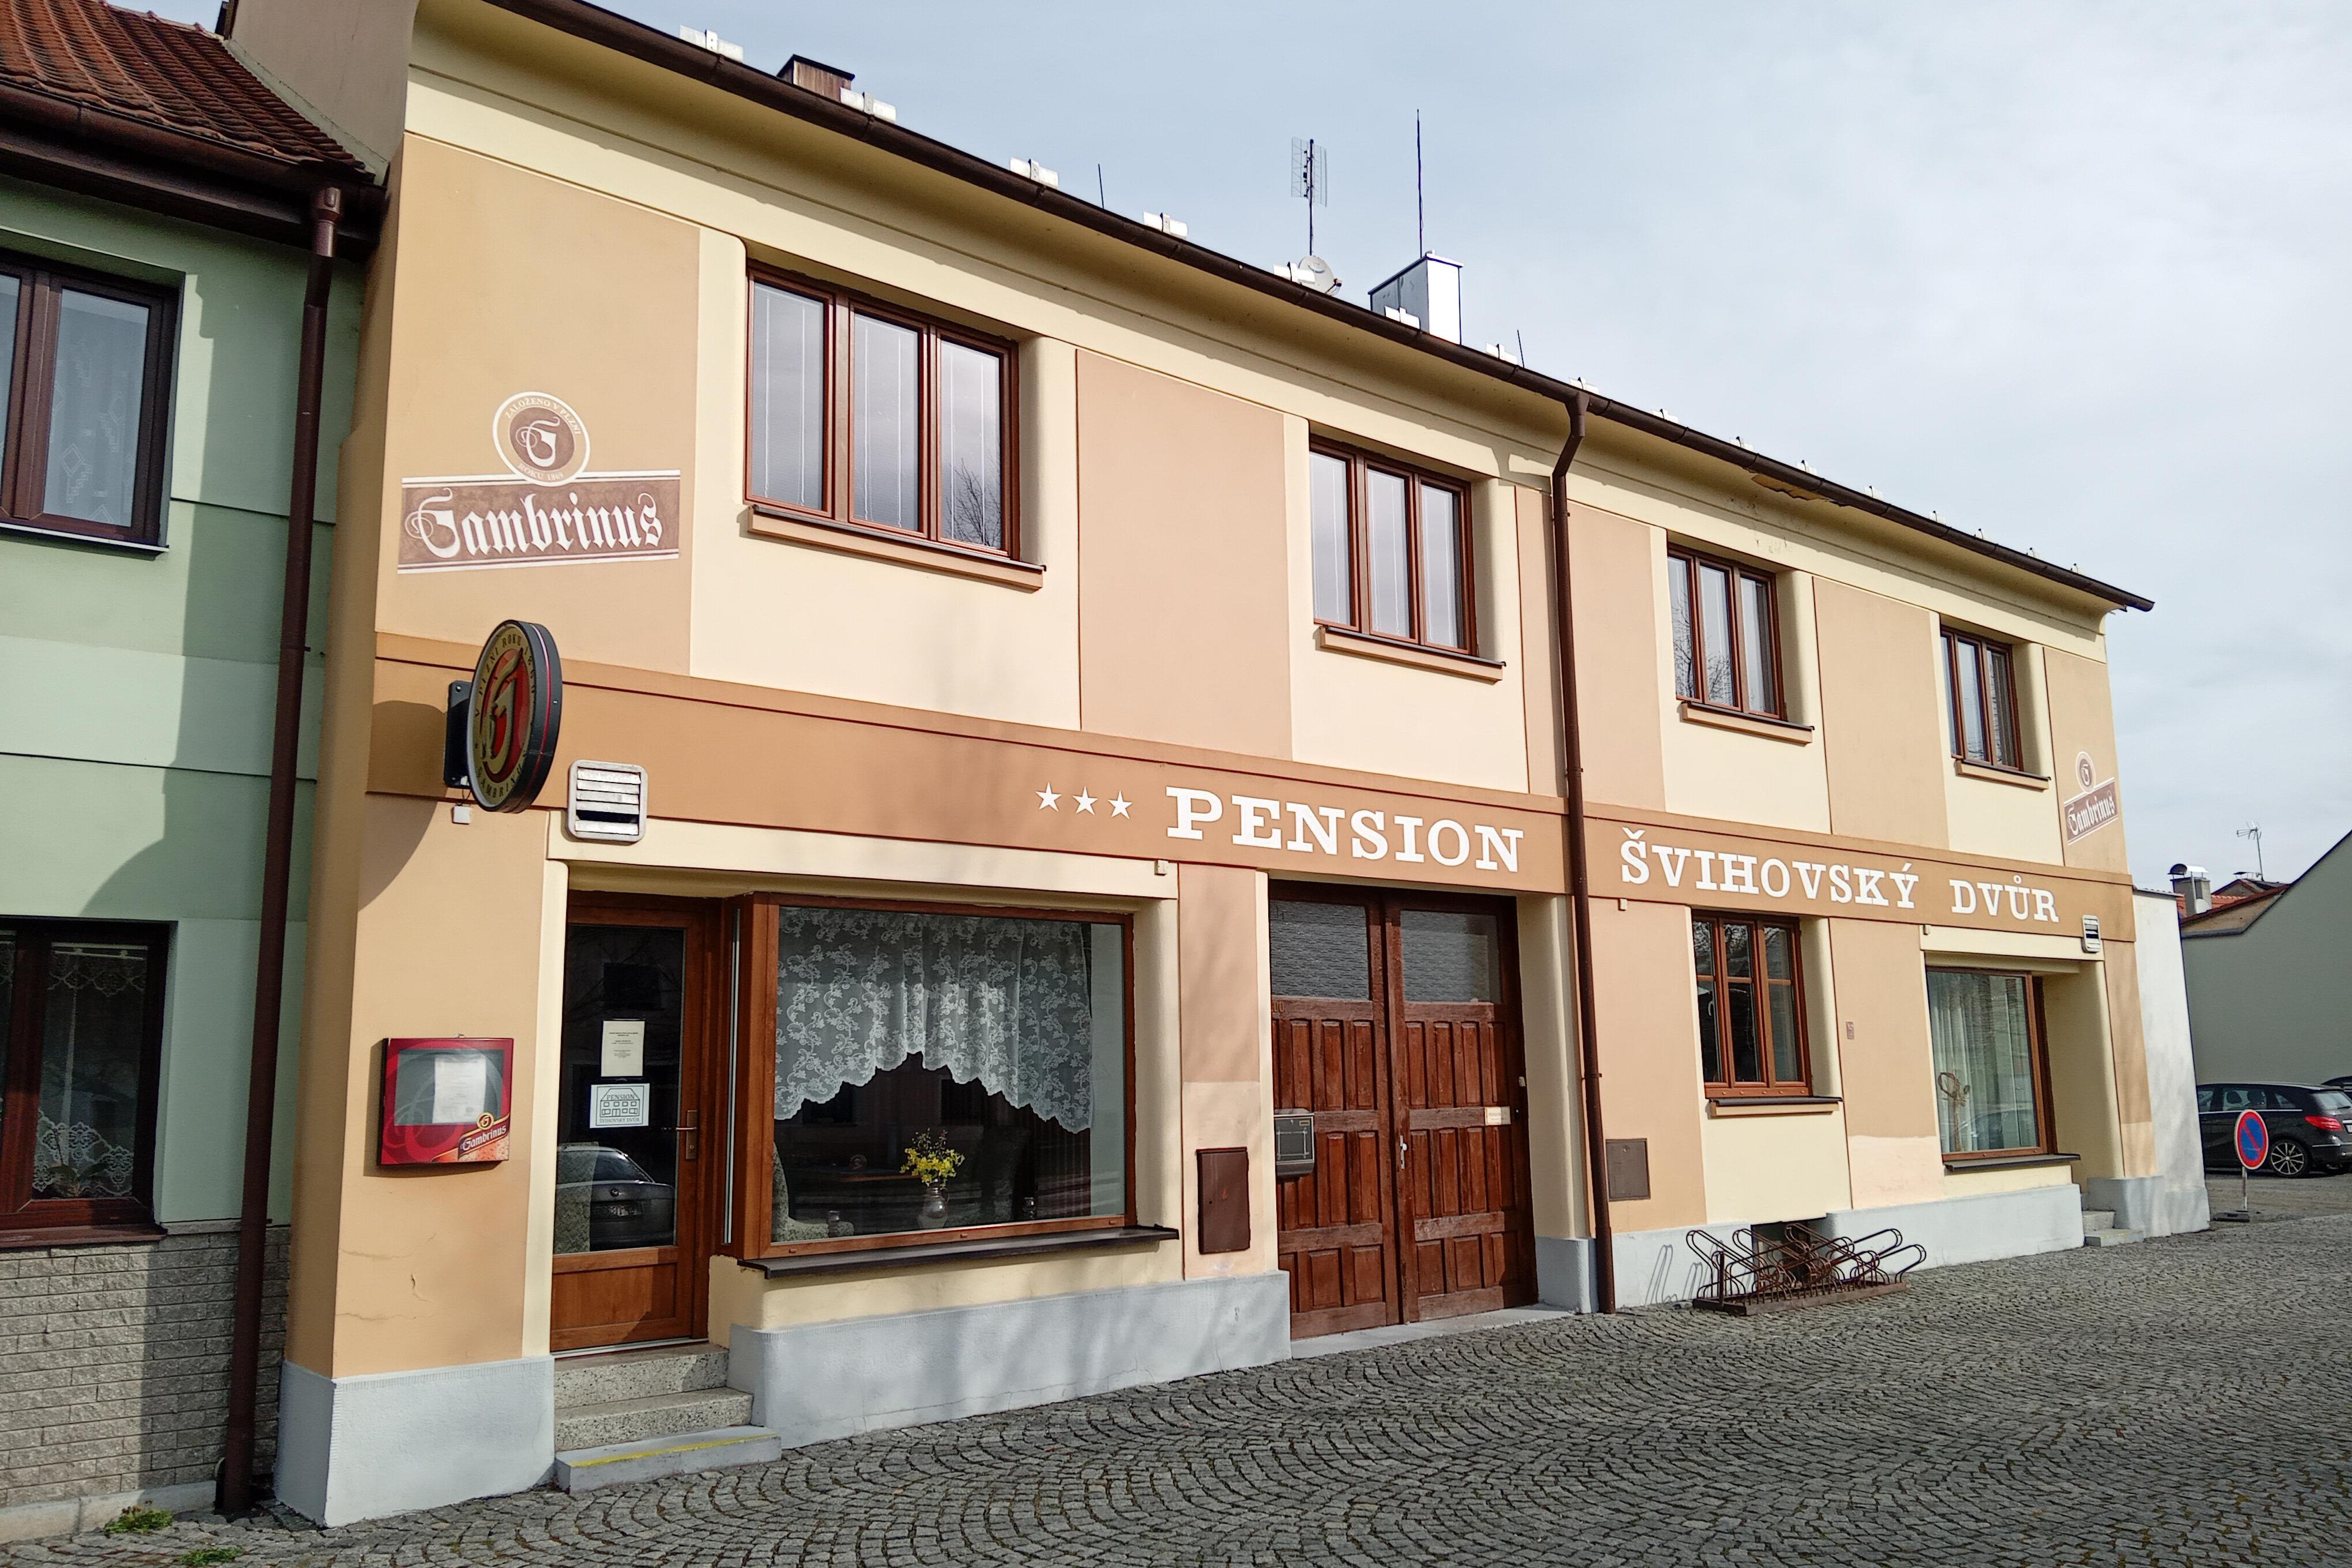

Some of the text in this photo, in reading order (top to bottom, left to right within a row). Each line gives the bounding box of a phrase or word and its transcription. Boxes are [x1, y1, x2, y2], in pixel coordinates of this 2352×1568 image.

[517, 463, 544, 479] ROKU
[405, 487, 663, 559] Gambrinus
[2067, 790, 2115, 836] Gambrinus
[1165, 786, 2060, 923] PENSION ŠVIHOVSKÝ DVŮR
[461, 1125, 506, 1151] Gambrinus
